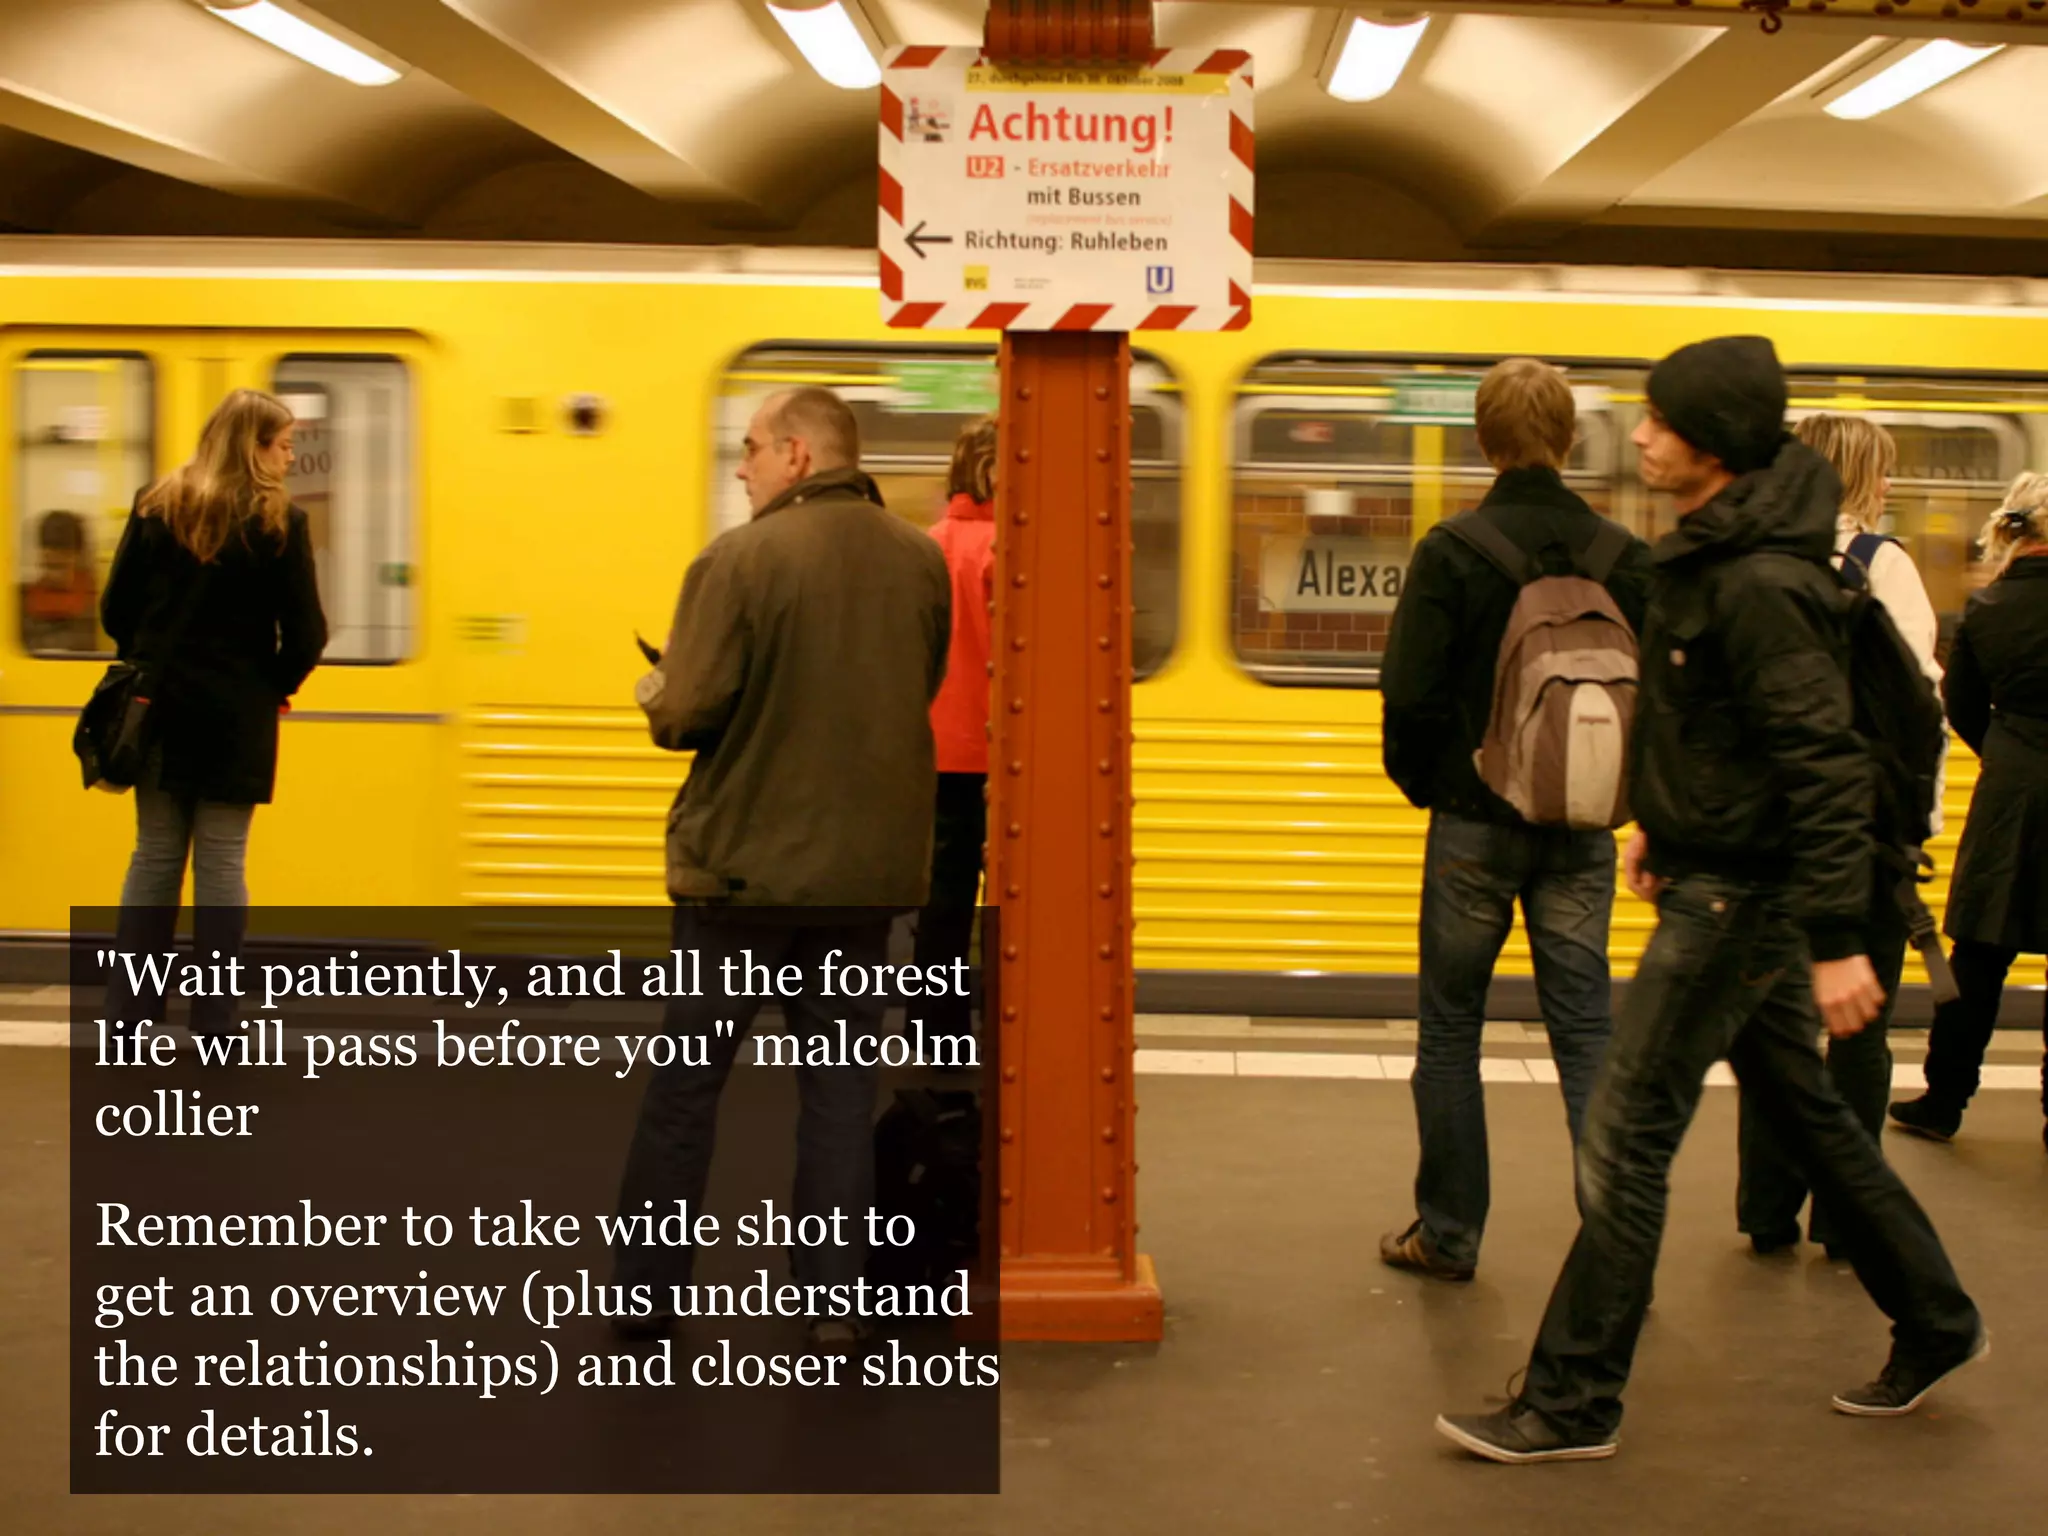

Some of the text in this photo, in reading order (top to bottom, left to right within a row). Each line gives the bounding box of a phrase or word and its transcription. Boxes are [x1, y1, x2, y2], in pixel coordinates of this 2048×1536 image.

[968, 100, 1173, 154] Achtung!
[969, 157, 1002, 178] U2
[1027, 157, 1171, 179] Ersatzverkehr
[1026, 186, 1141, 206] mit Bussen
[964, 229, 1169, 255] Richtung: Ruhleben
[1148, 267, 1171, 293] U
[1297, 548, 1409, 598] Alexa
